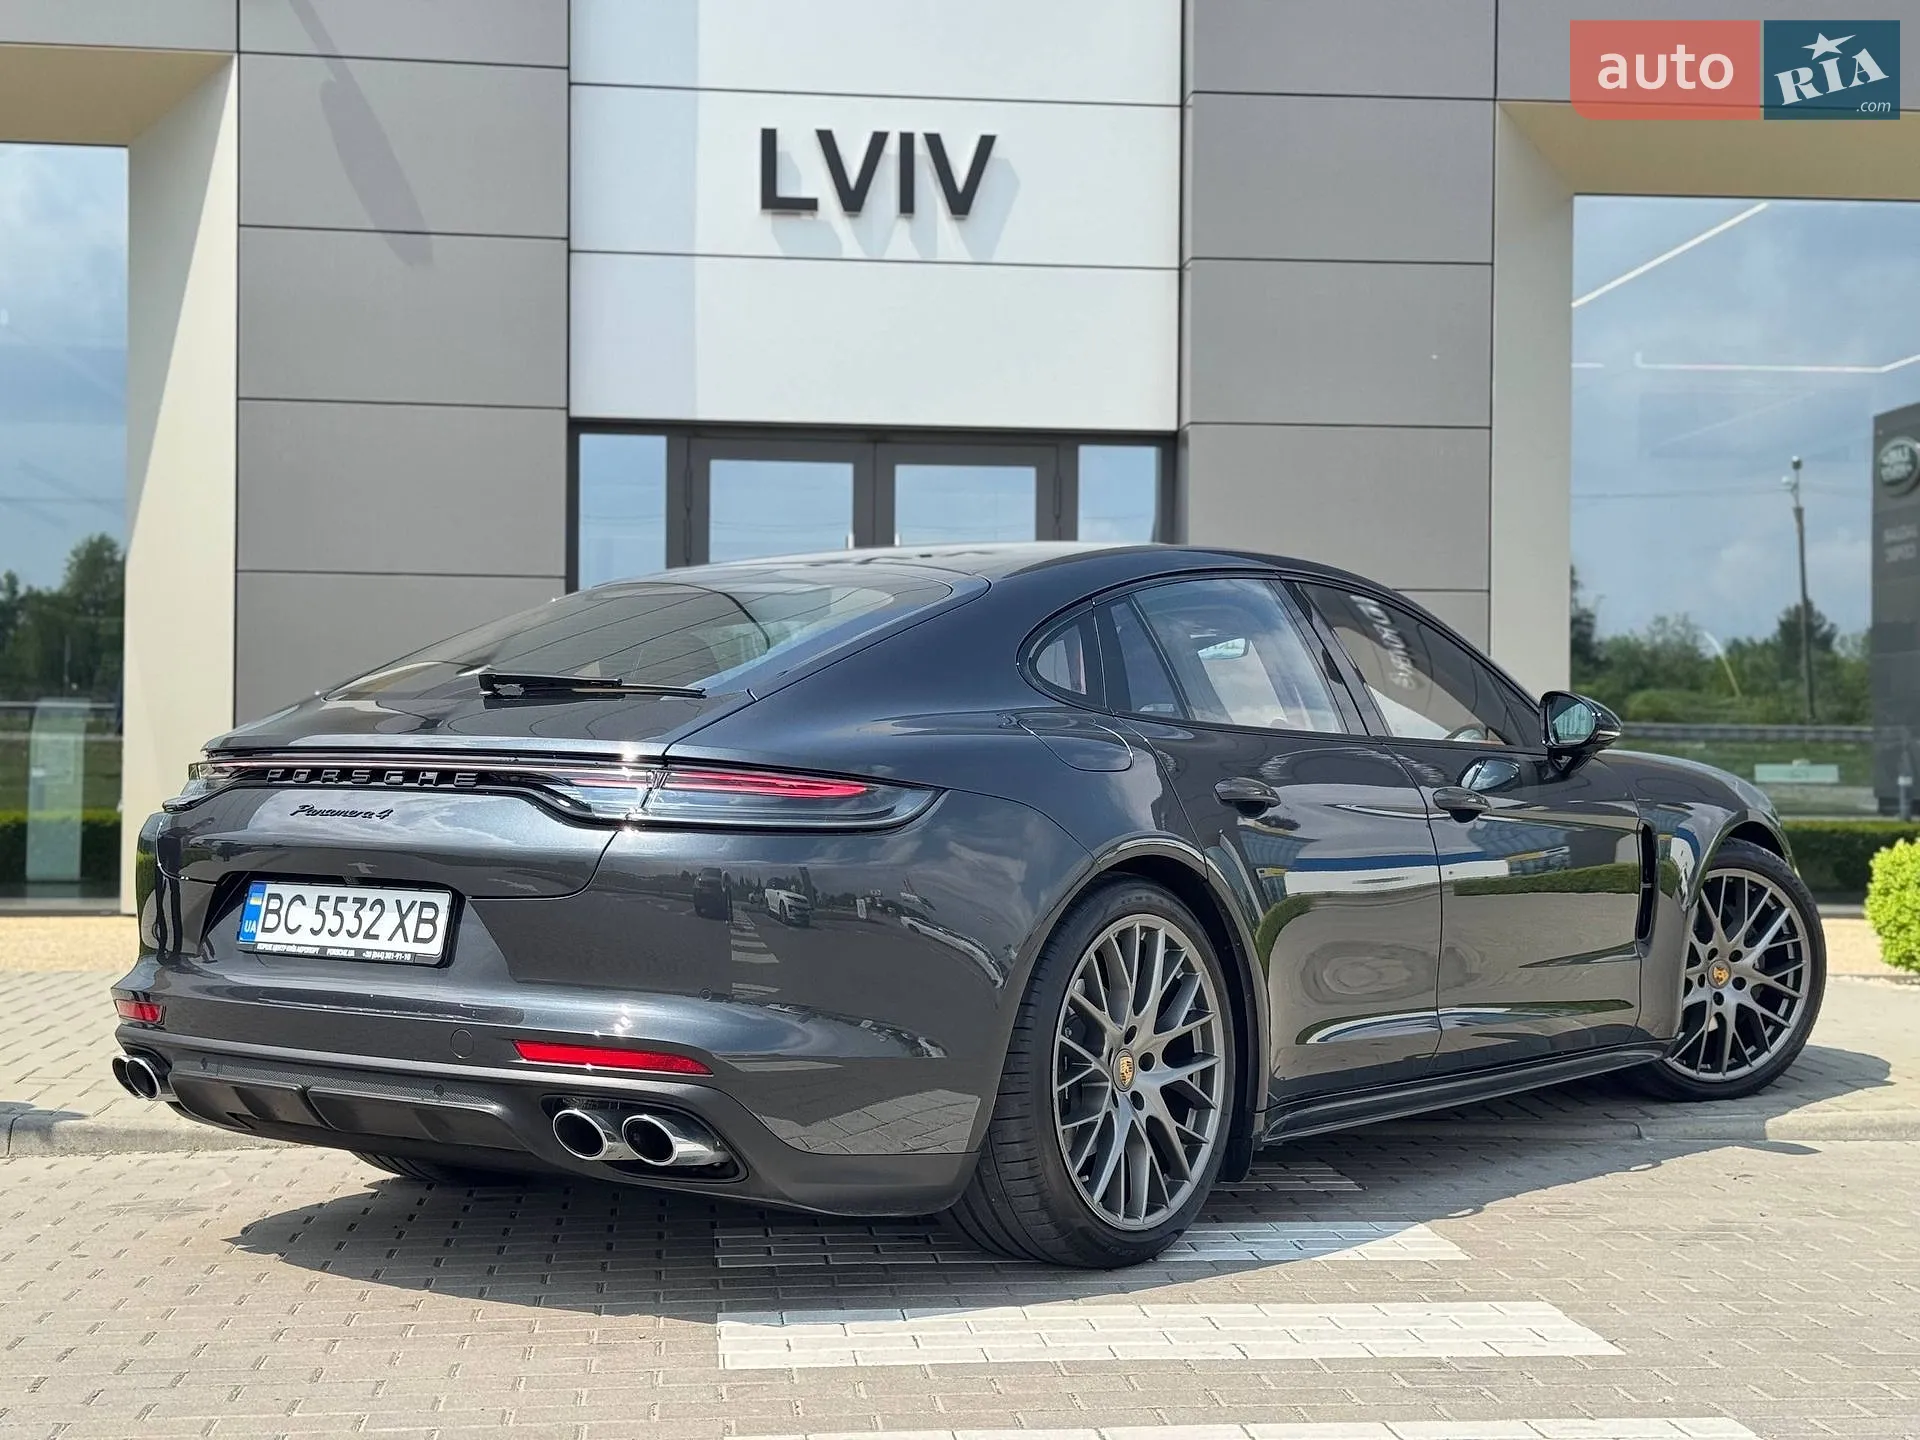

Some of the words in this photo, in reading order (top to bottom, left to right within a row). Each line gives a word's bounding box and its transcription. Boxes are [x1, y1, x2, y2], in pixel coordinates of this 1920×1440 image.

[760, 127, 997, 217] LVIV
[266, 768, 478, 788] PORSCHE
[289, 803, 375, 819] Panamera
[375, 808, 394, 820] 4
[243, 920, 257, 933] UA
[260, 892, 307, 935] BC
[309, 895, 386, 940] 5532
[387, 899, 440, 945] XB
